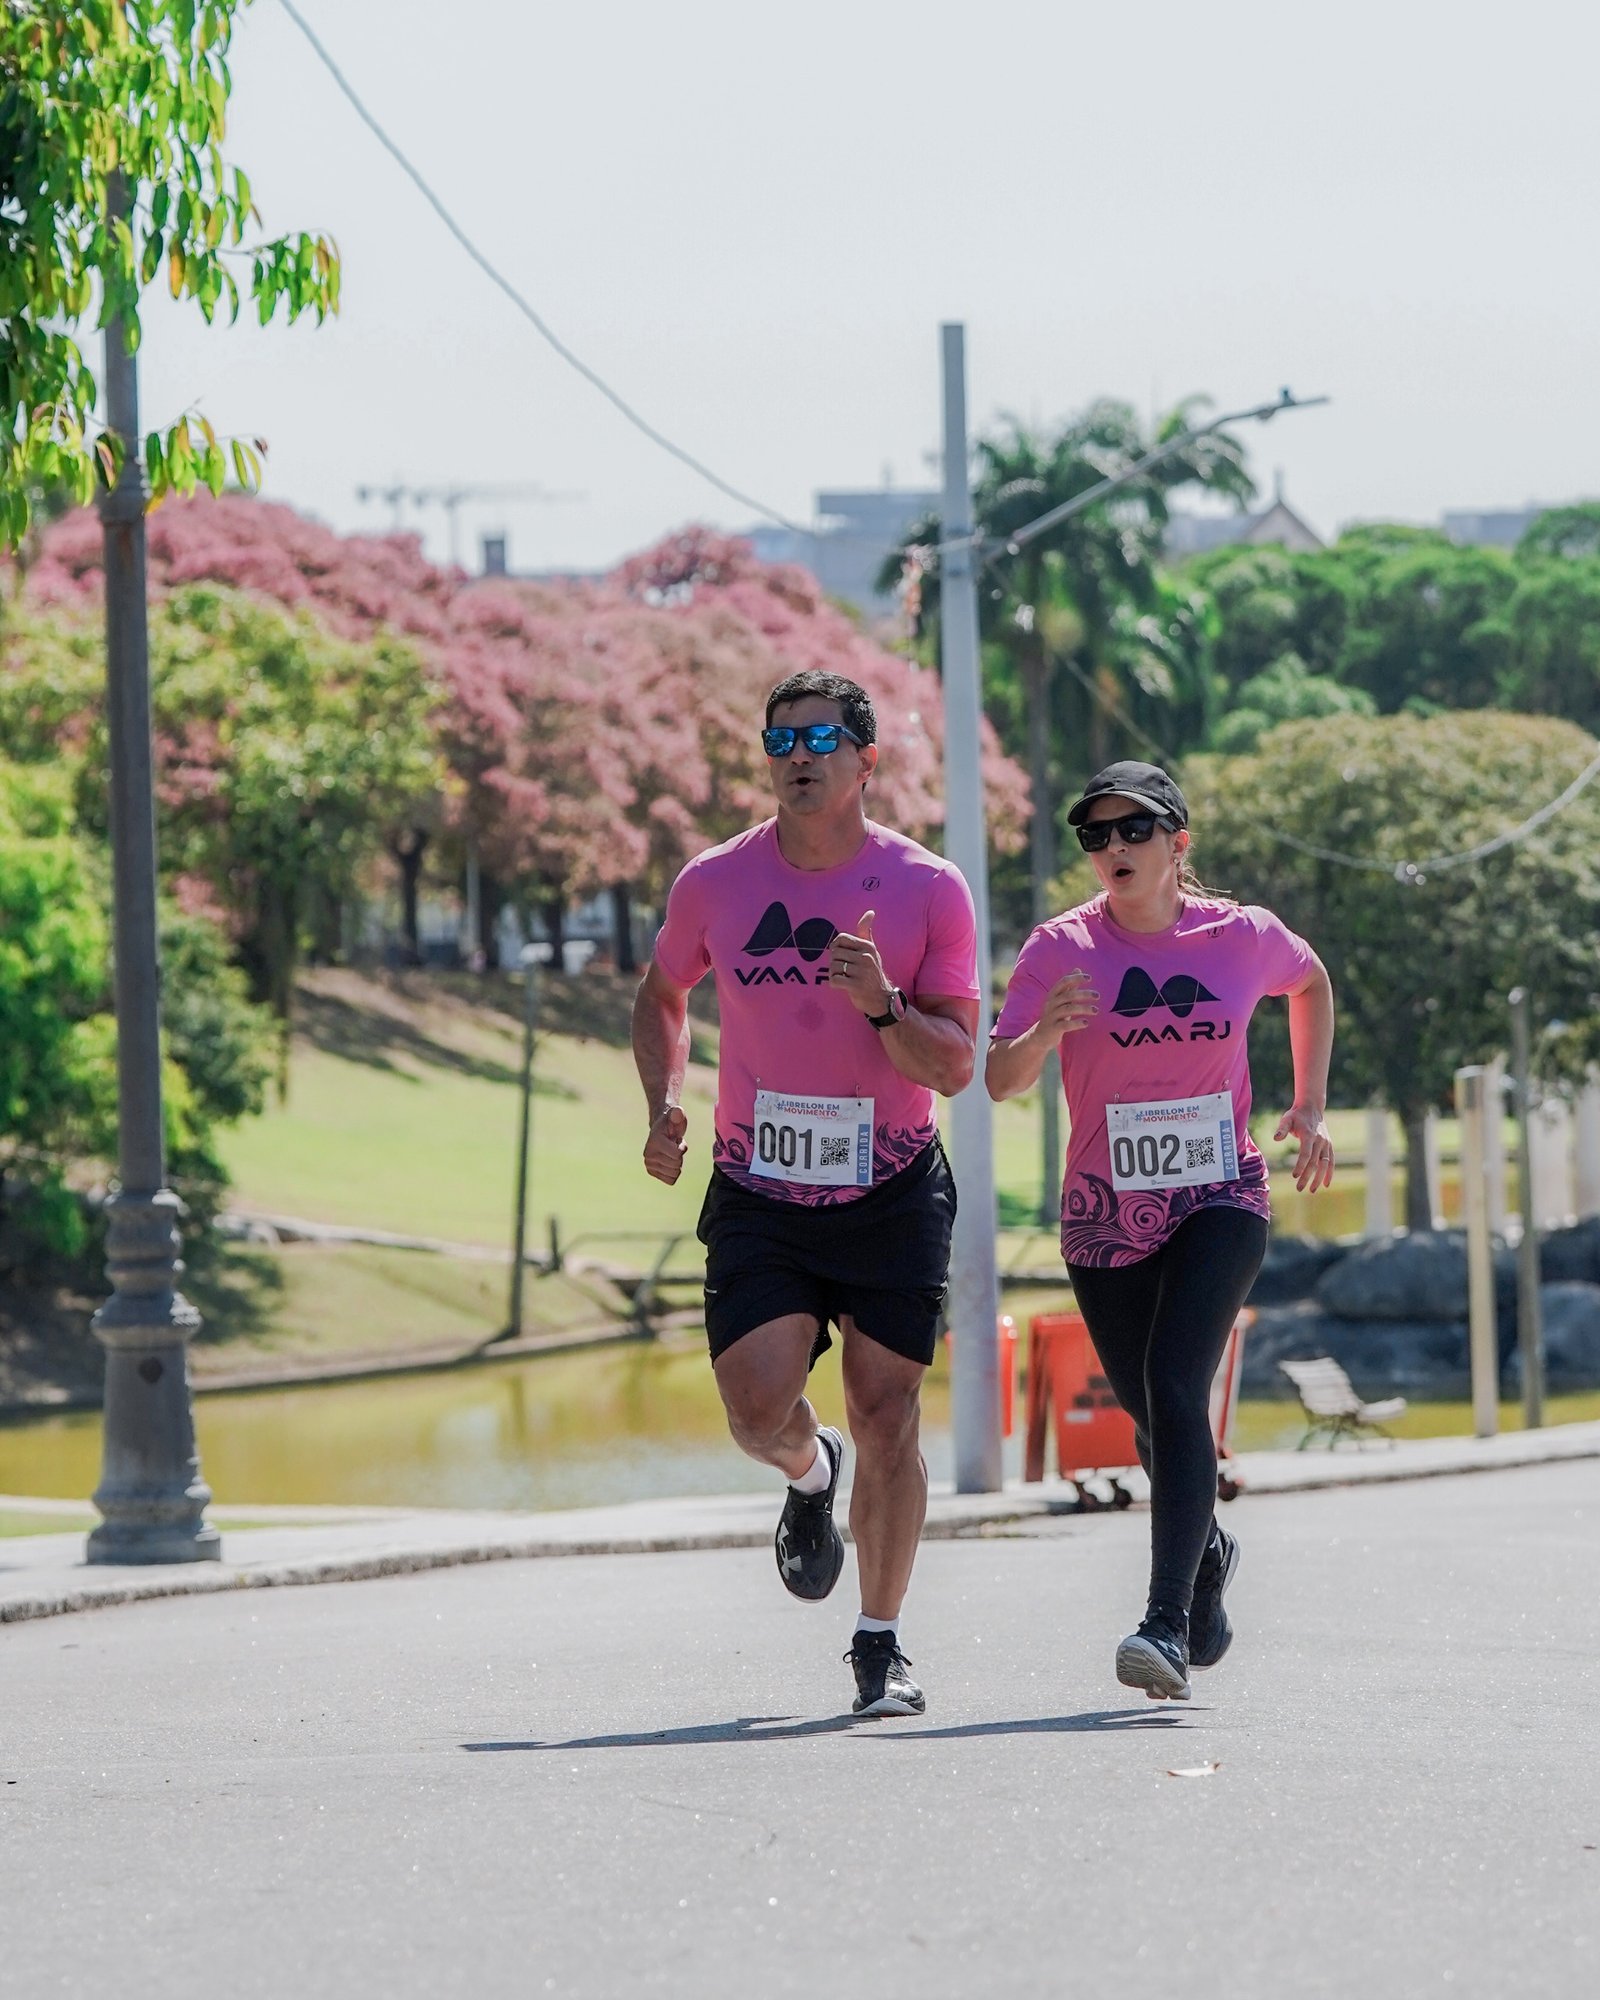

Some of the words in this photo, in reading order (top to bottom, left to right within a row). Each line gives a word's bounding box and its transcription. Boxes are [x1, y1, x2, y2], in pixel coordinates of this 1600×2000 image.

[734, 965, 808, 986] VAA
[815, 967, 830, 985] R
[1109, 1024, 1184, 1048] VAA
[1190, 1020, 1231, 1041] RJ
[784, 1107, 838, 1117] MOVIMENTO
[827, 1103, 840, 1111] EM
[1143, 1112, 1198, 1123] MOVIMENTO
[1187, 1105, 1200, 1113] EM
[759, 1121, 813, 1170] 001
[858, 1131, 869, 1174] CORRIDA
[1113, 1134, 1182, 1178] 002
[1222, 1127, 1233, 1170] CORRIDA
